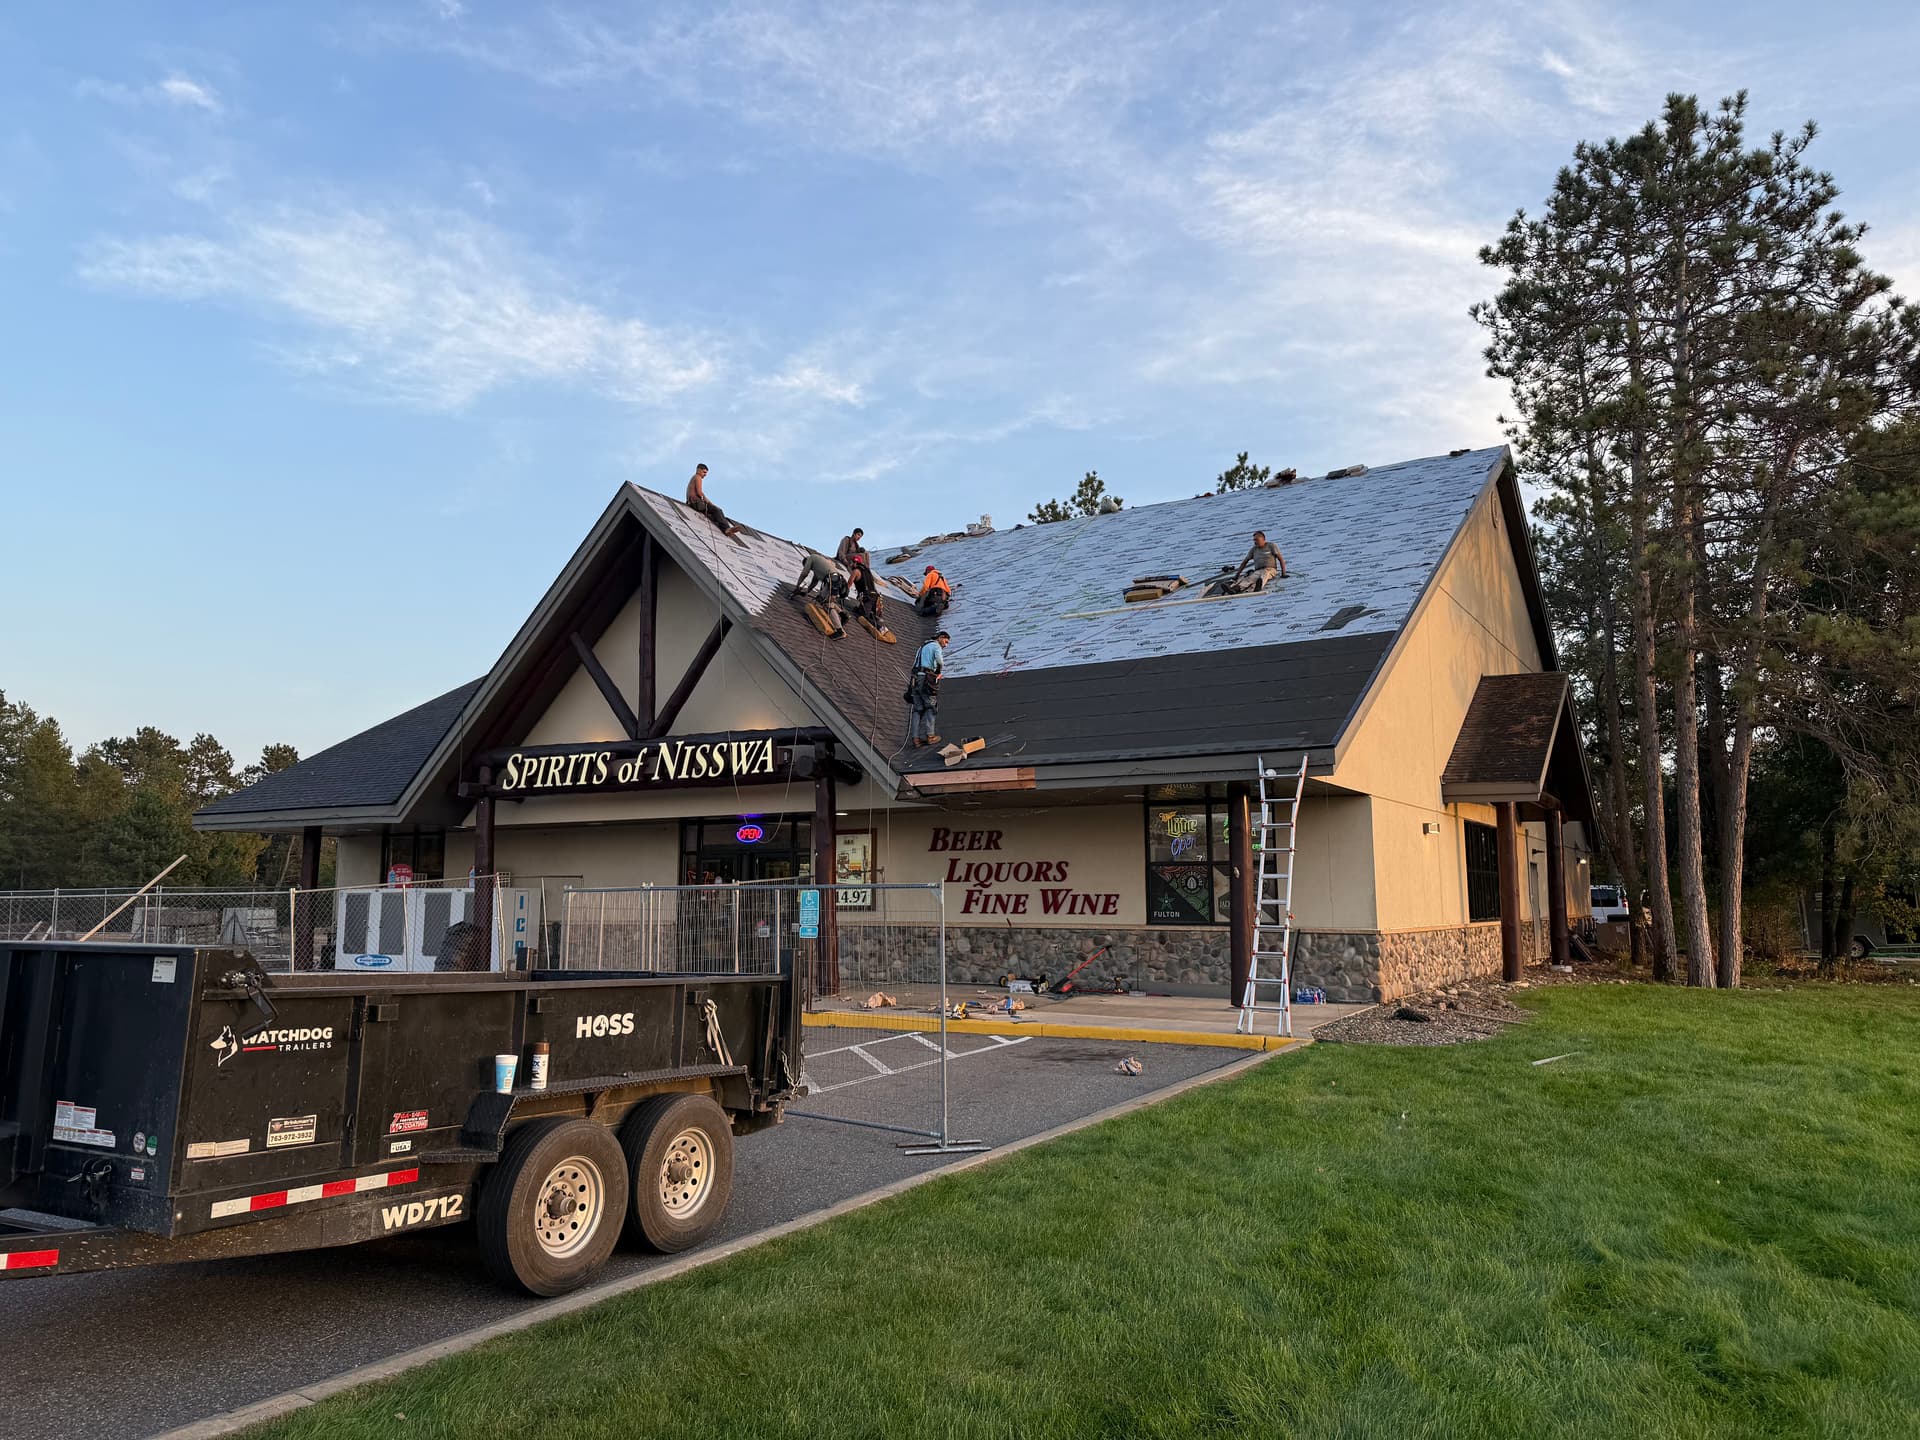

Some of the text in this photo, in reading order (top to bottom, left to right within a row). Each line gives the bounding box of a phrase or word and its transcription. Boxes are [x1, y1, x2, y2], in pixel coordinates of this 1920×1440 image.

[502, 737, 774, 790] SPIRITS of NISSWA
[738, 828, 760, 840] OPEN
[928, 827, 1003, 852] BEER
[1167, 817, 1198, 838] Lite
[944, 858, 1069, 888] LIQUORS
[960, 888, 1120, 915] FINE WINE
[576, 1012, 635, 1039] HOSS
[278, 1041, 332, 1052] TRAILERS
[381, 1194, 464, 1230] WD712
